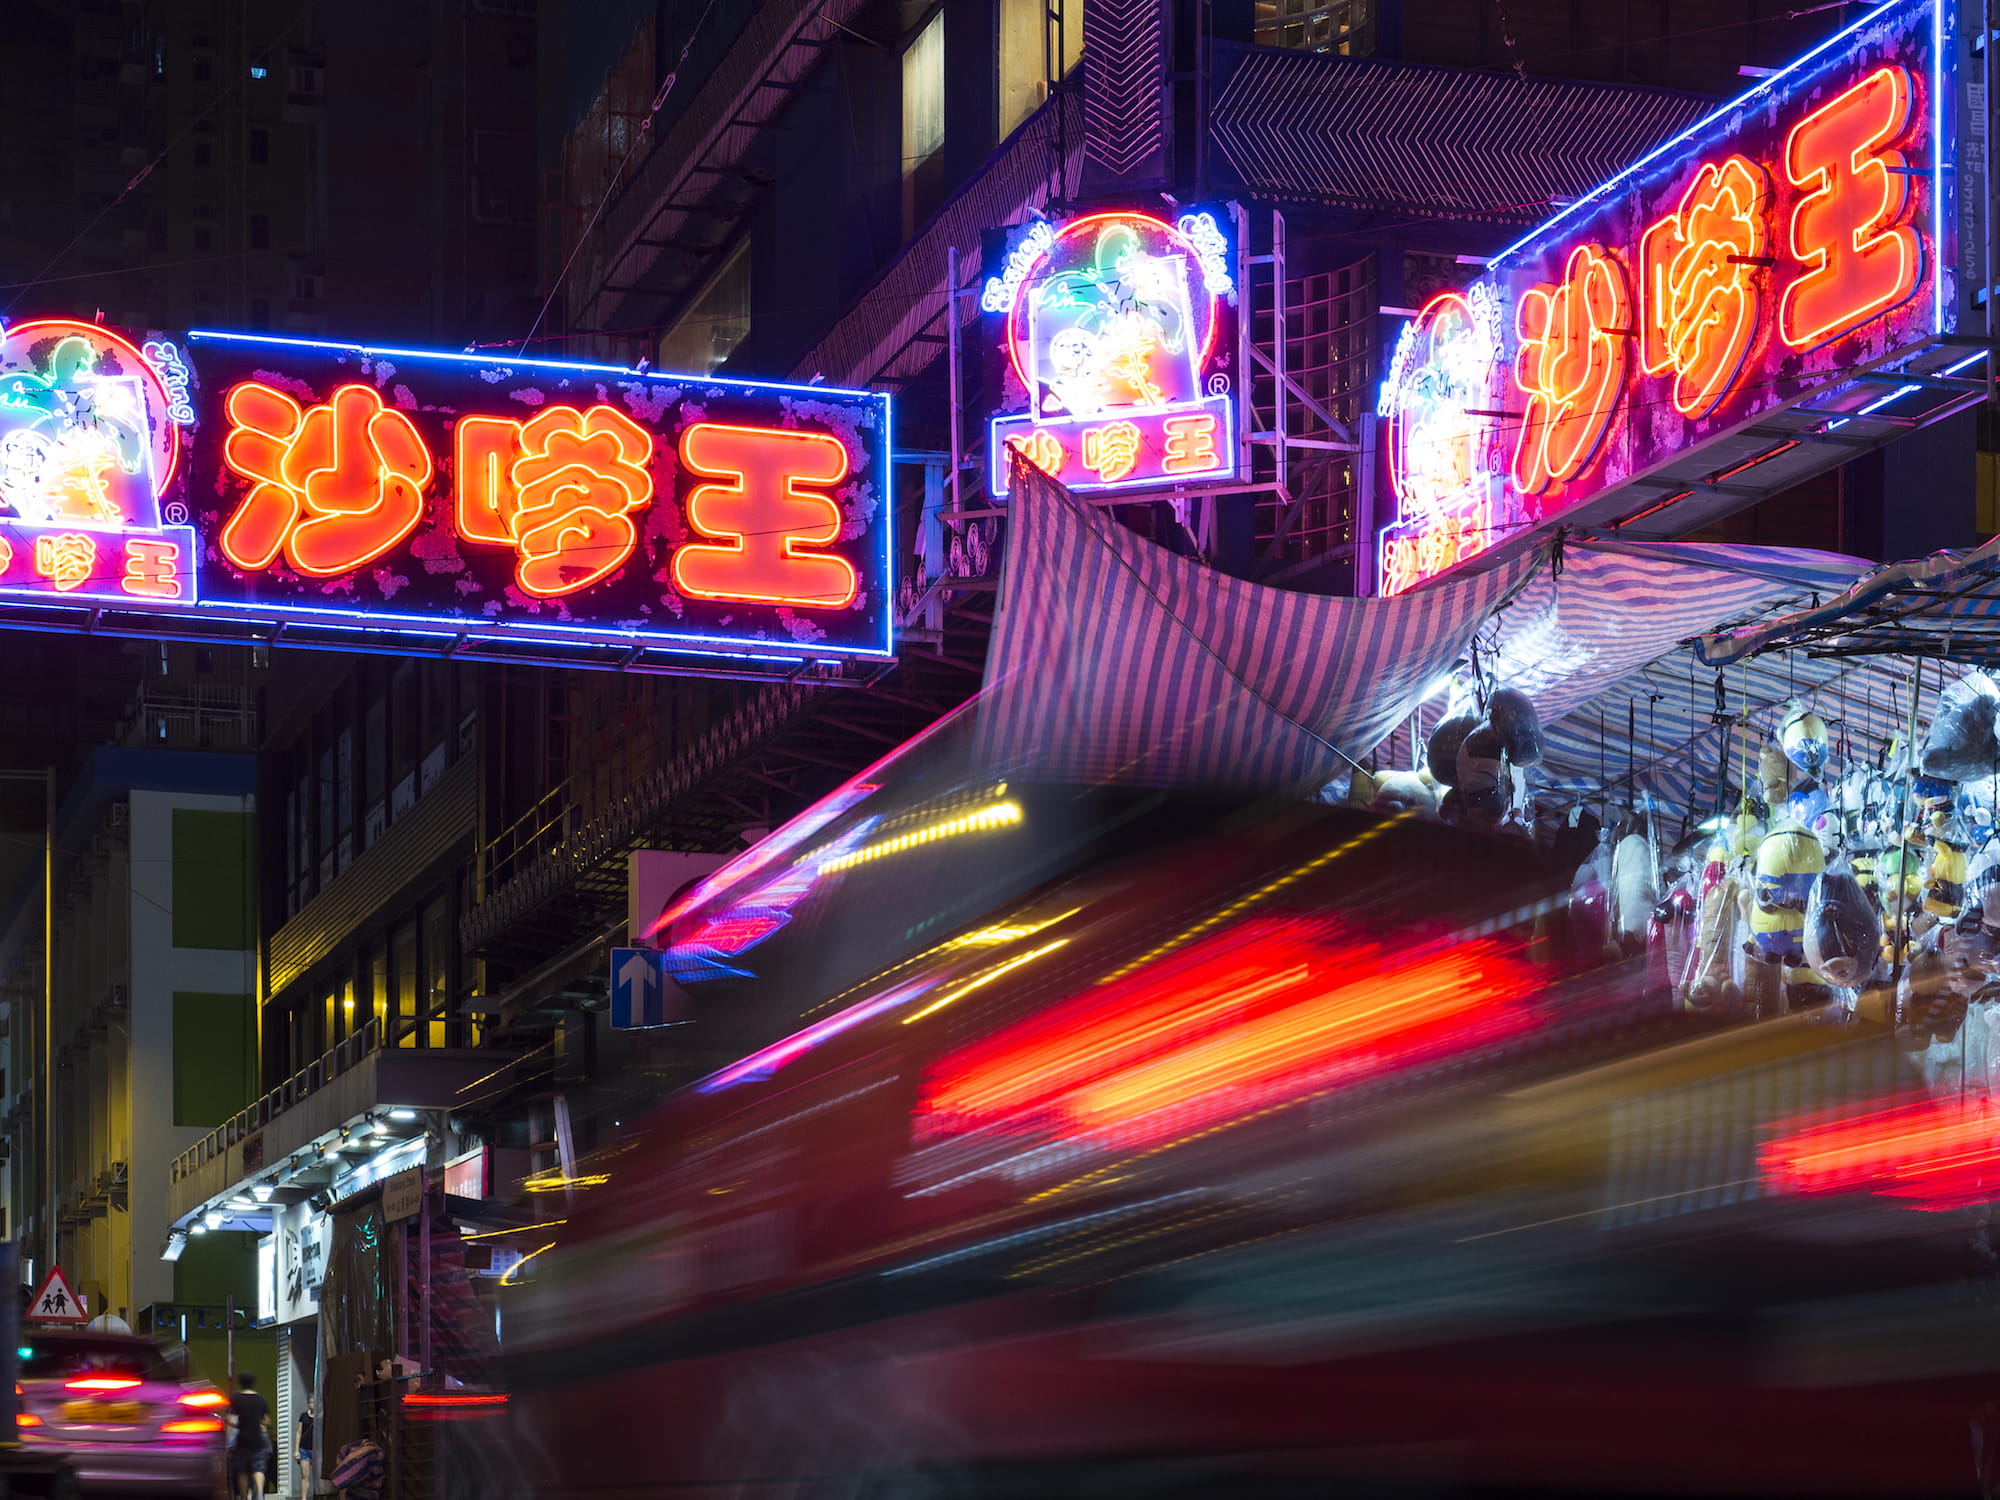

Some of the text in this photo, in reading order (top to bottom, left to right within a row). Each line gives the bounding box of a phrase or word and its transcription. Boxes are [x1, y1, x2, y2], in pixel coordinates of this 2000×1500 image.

[1511, 65, 1922, 496] 沙嗲王
[142, 341, 195, 424] King
[0, 533, 181, 599] 嗲王
[220, 382, 858, 610] 沙嗲王
